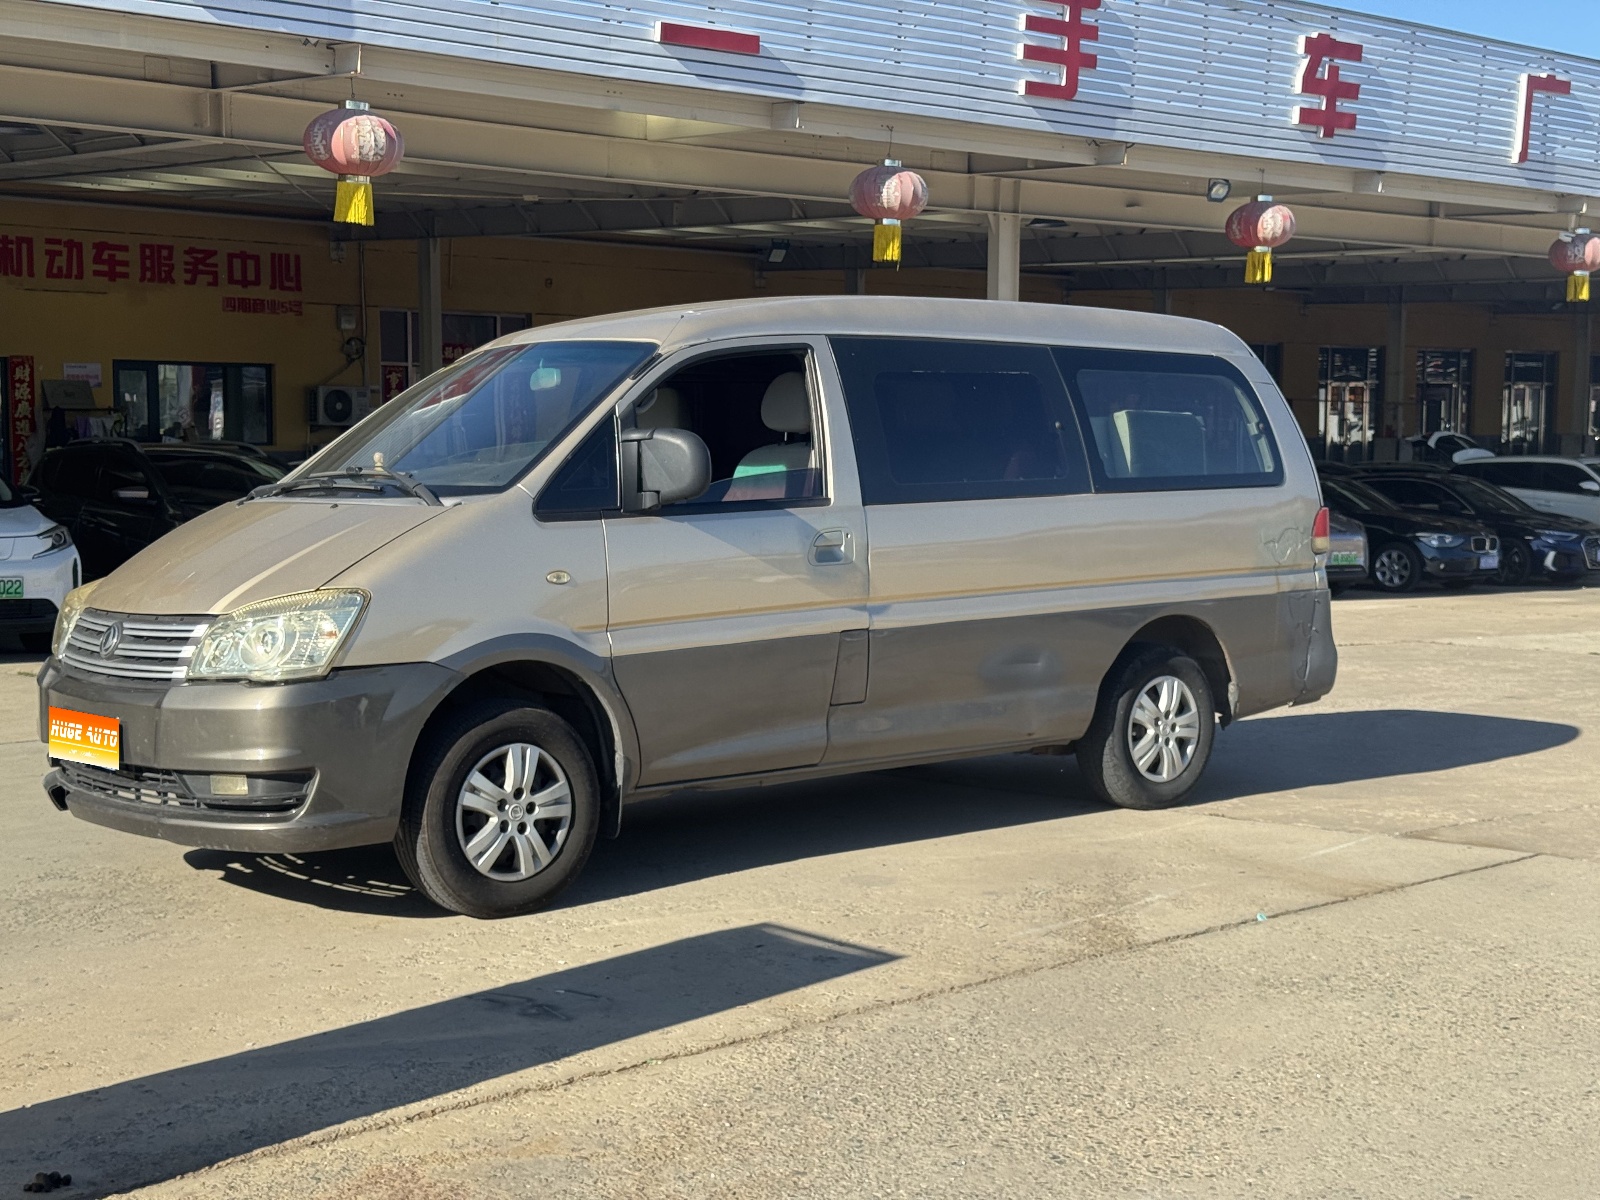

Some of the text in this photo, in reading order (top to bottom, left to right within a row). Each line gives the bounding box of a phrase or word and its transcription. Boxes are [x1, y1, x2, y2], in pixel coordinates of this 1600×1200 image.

[0, 234, 303, 292] 机动车服务中心
